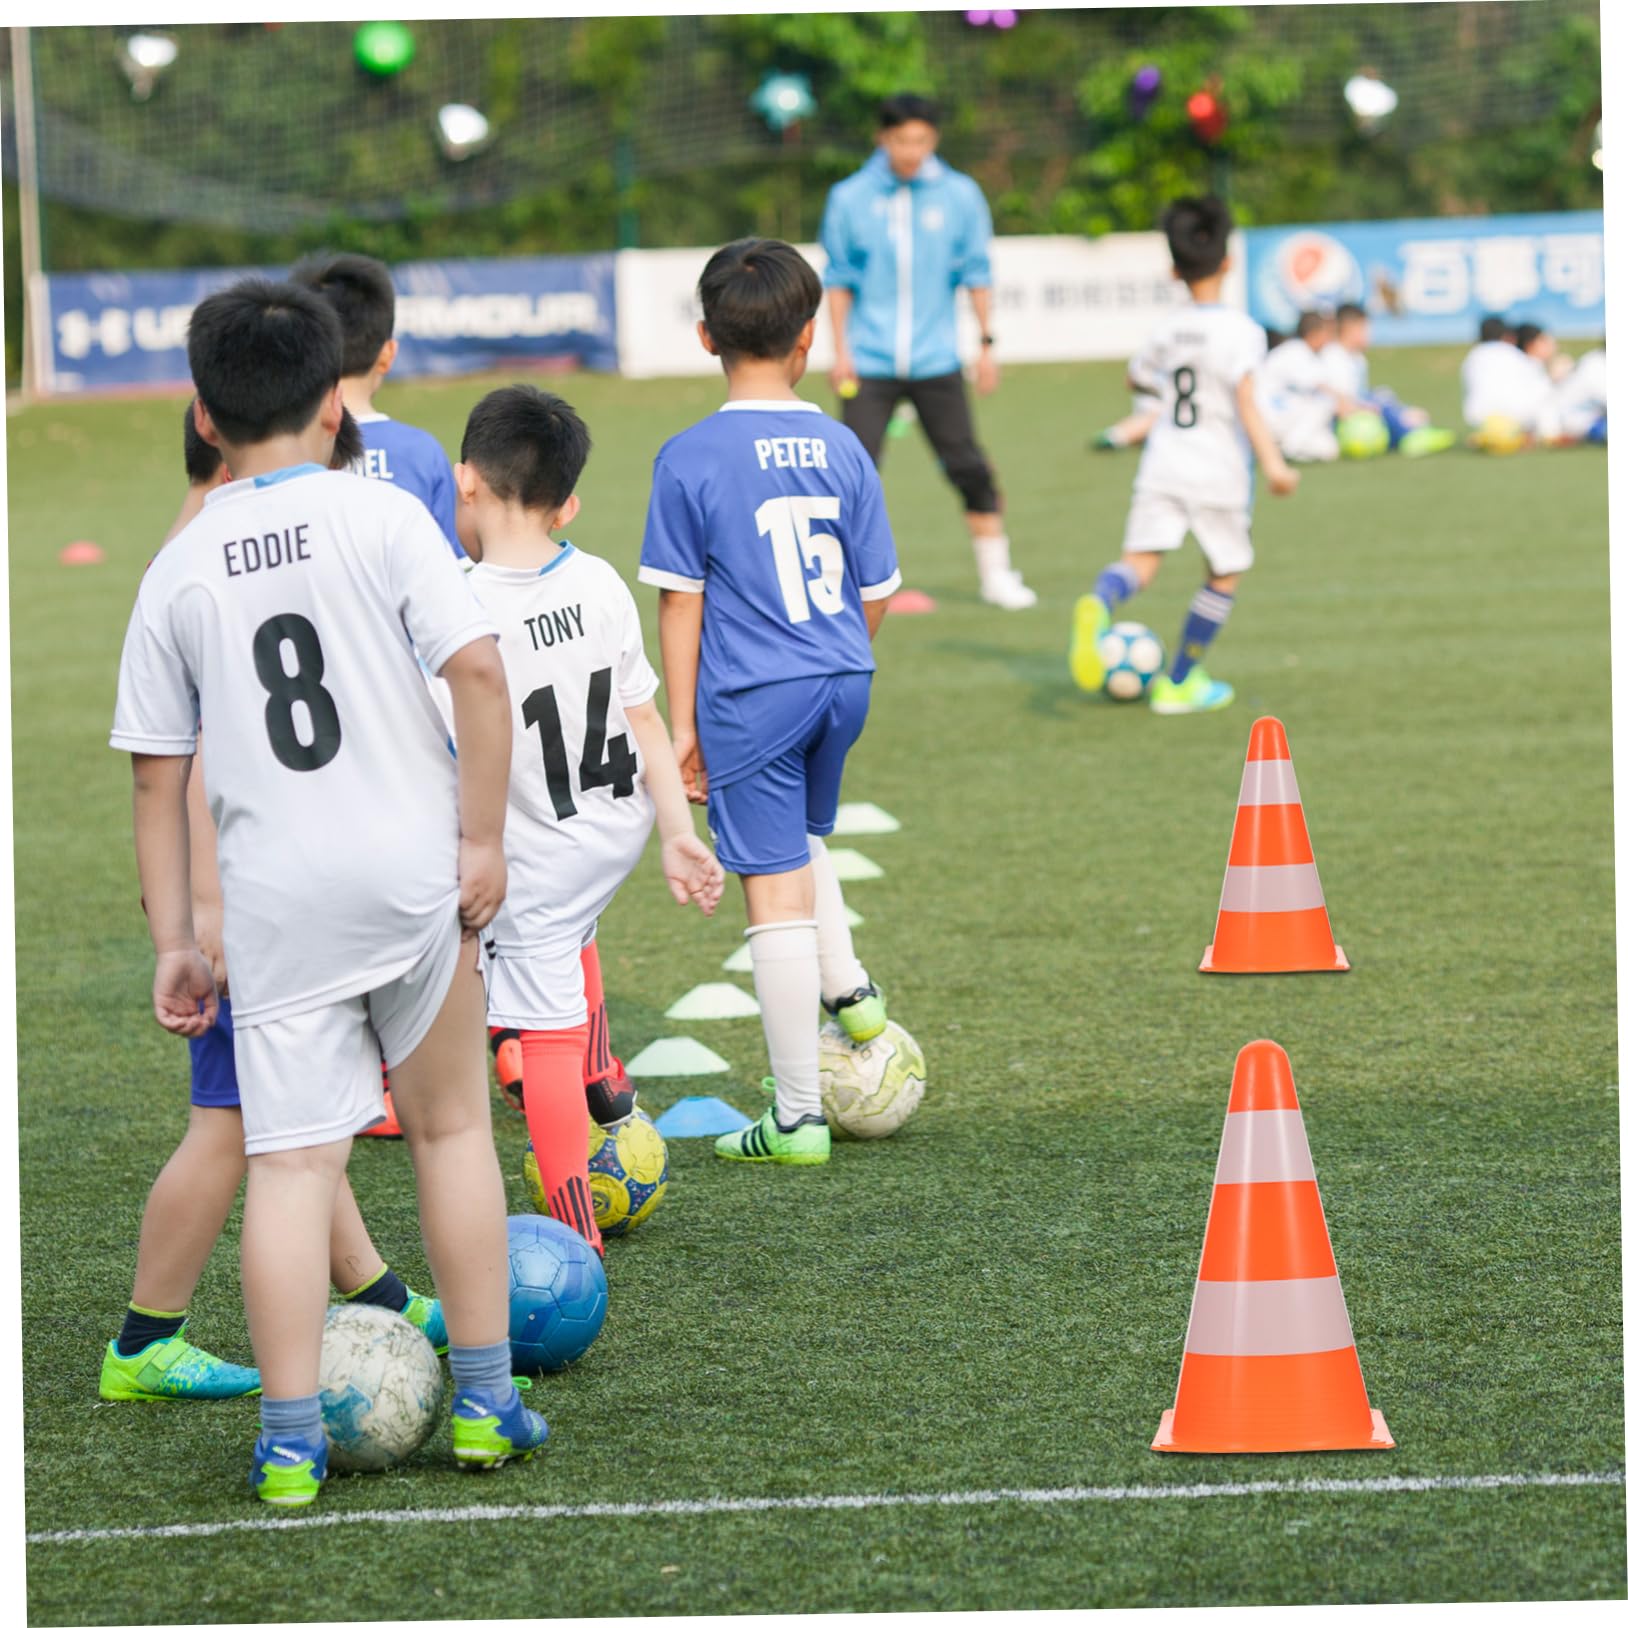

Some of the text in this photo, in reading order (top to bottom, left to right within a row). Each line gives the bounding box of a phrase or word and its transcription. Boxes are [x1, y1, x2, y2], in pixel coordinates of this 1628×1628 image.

[1173, 366, 1197, 428] 8
[754, 436, 829, 470] PETER
[222, 524, 312, 577] EDDIE
[754, 495, 845, 624] 15
[523, 603, 585, 651] TONY
[252, 612, 342, 772] 8
[521, 666, 637, 821] 14
